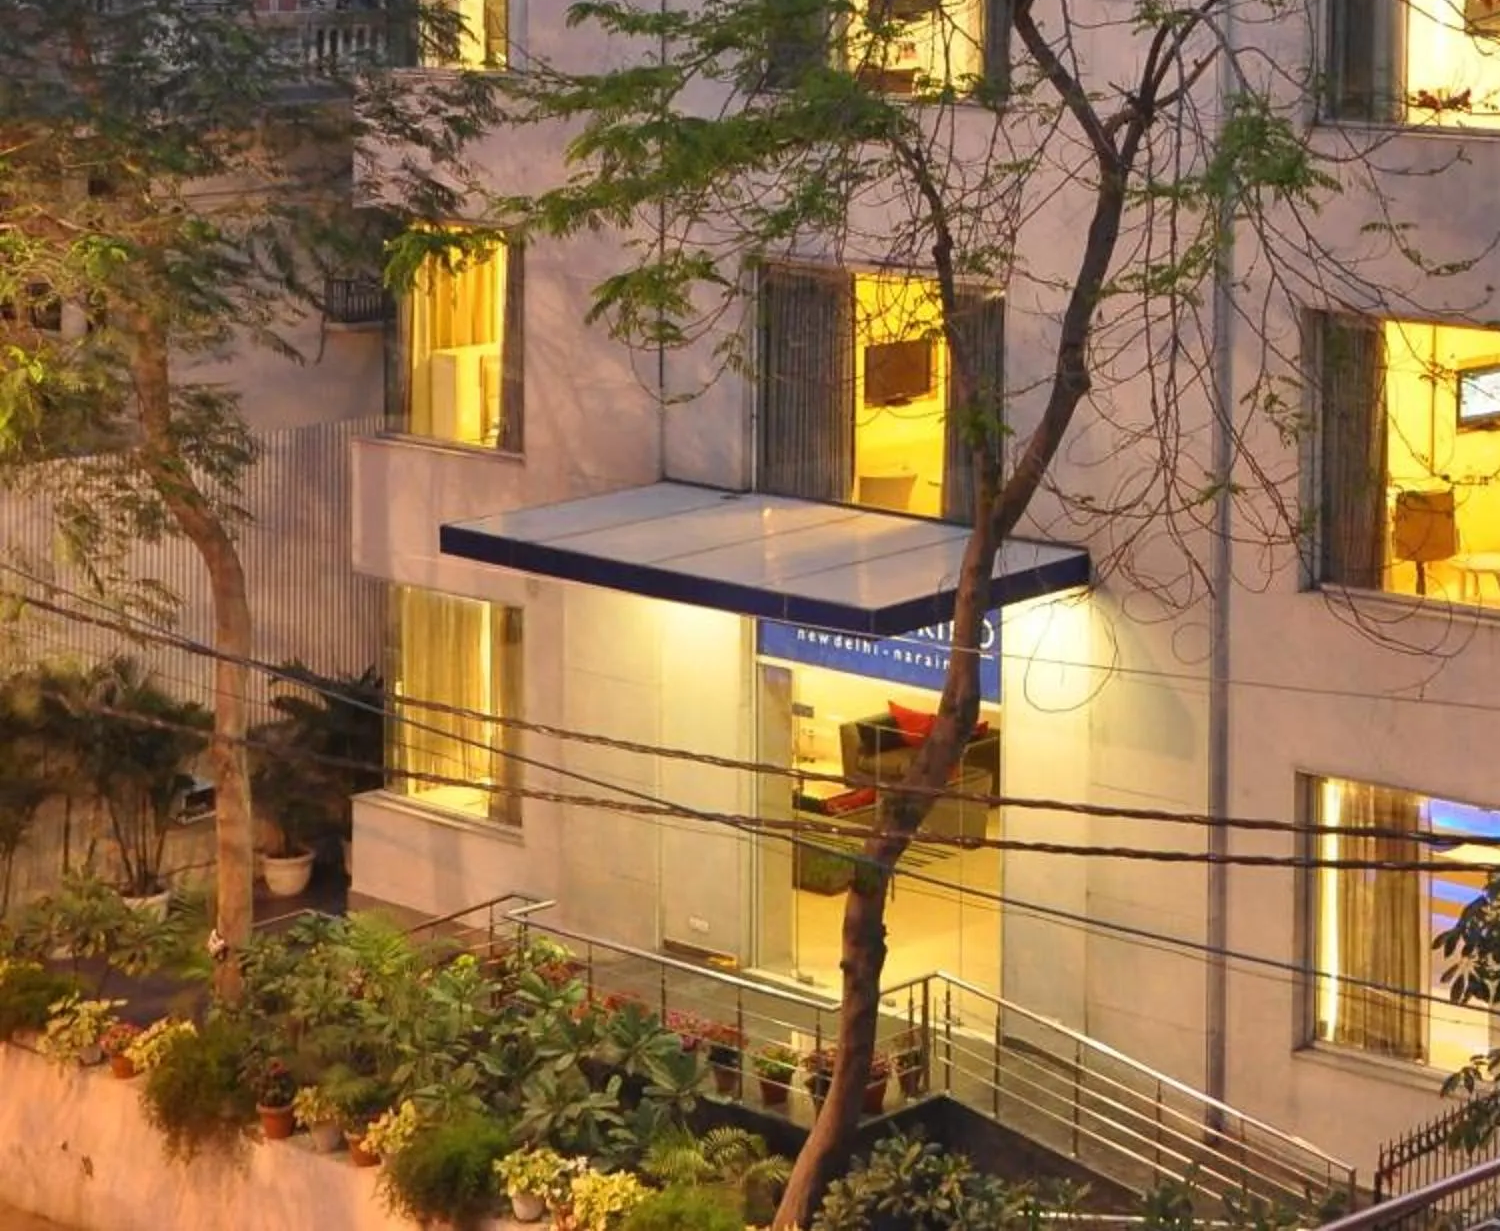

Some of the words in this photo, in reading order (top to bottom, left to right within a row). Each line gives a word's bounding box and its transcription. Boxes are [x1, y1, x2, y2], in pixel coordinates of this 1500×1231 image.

[797, 628, 829, 645] new
[833, 635, 878, 656] delhi
[893, 649, 951, 670] narain
